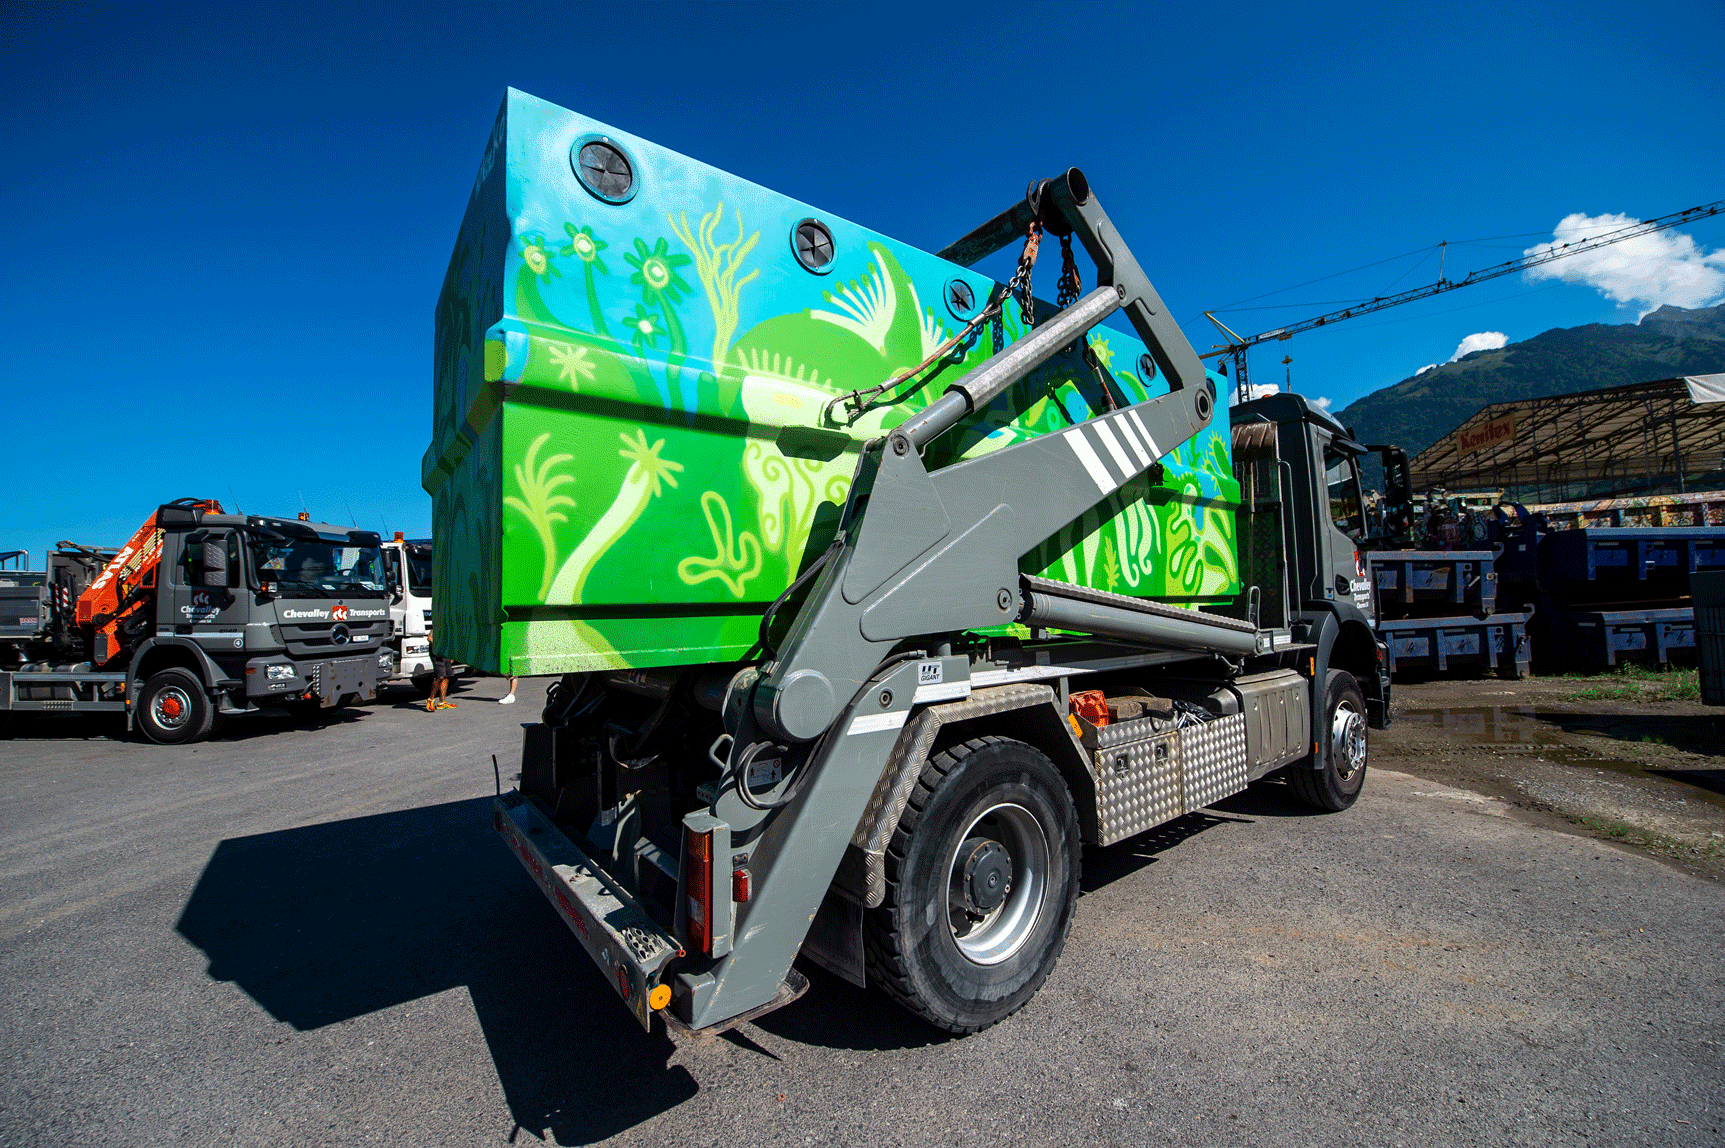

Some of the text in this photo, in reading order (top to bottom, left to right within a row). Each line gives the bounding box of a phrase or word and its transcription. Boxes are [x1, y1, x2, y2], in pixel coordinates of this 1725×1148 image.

[91, 546, 134, 590] ATLAS
[283, 608, 330, 619] Chevalley
[349, 608, 386, 618] Transports
